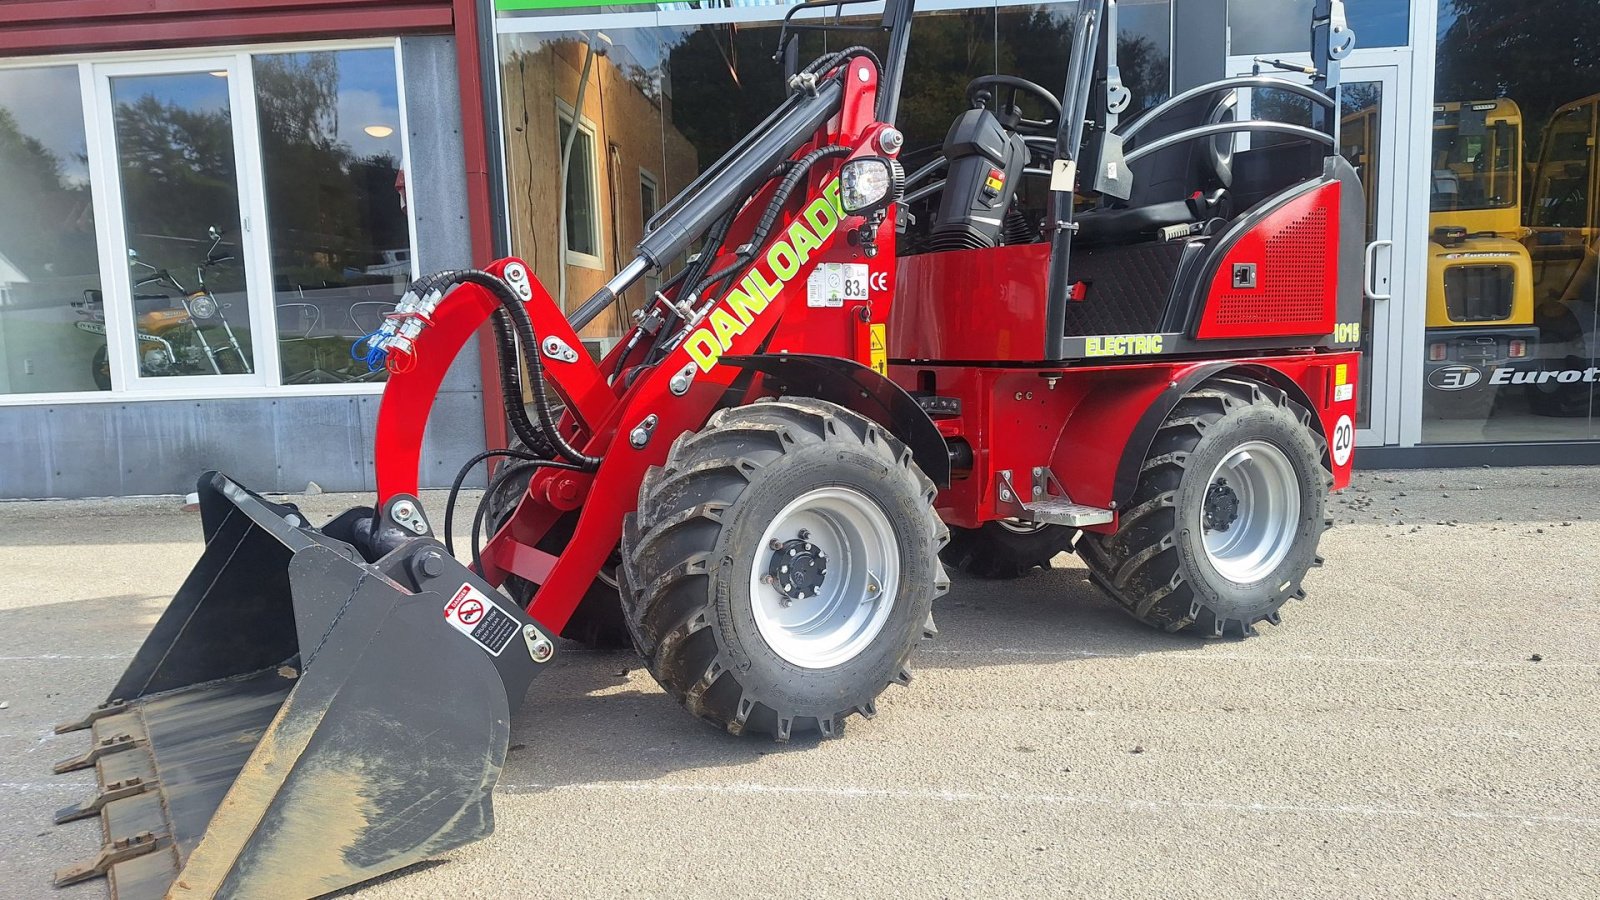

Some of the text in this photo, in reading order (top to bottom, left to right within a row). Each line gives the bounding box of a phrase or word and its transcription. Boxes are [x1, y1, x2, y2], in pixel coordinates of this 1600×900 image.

[845, 279, 860, 296] 83
[869, 271, 888, 291] CE
[1334, 322, 1360, 344] 1015
[1085, 335, 1163, 357] ELECTRIC
[1489, 367, 1600, 385] Eurot
[1336, 424, 1351, 451] 20
[451, 589, 468, 608] DANGER
[474, 610, 498, 637] CRUSH RISK
[480, 617, 500, 641] KEEP CLEAR
